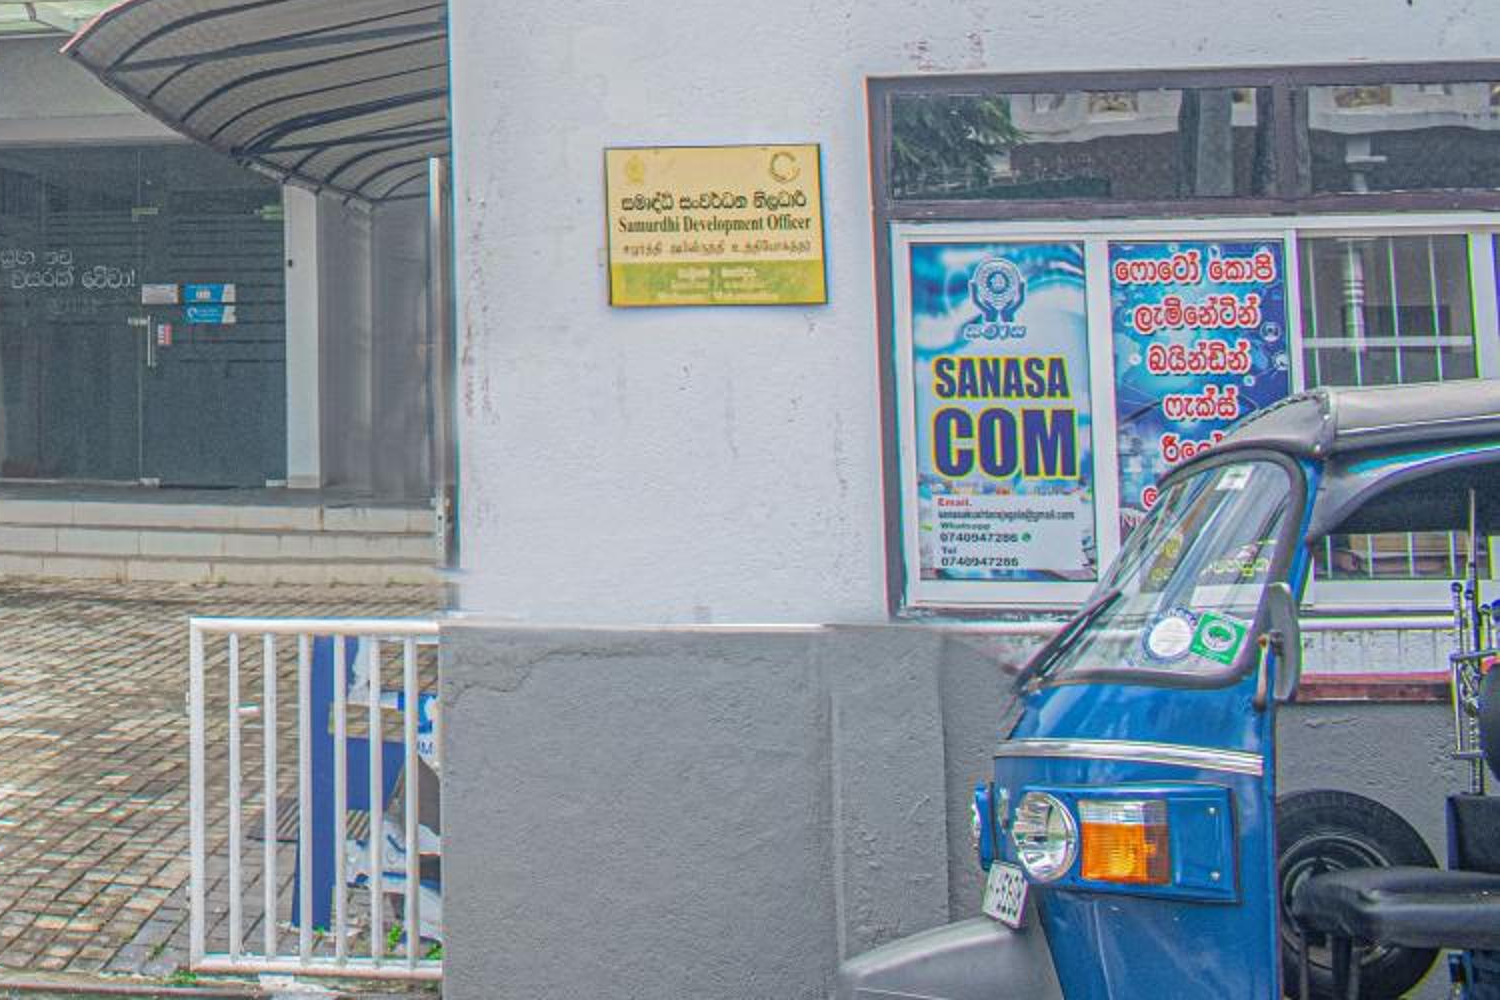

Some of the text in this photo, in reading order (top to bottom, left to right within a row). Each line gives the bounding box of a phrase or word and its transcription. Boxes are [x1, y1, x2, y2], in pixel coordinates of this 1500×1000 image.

[618, 214, 812, 235] Samurdhi Development Officer
[1115, 252, 1275, 284] ෆොටෝ කොපි
[933, 356, 1069, 400] SANASA
[1163, 387, 1239, 420] ෆැක්ස්
[933, 407, 1080, 480] COM
[940, 546, 958, 555] Tel
